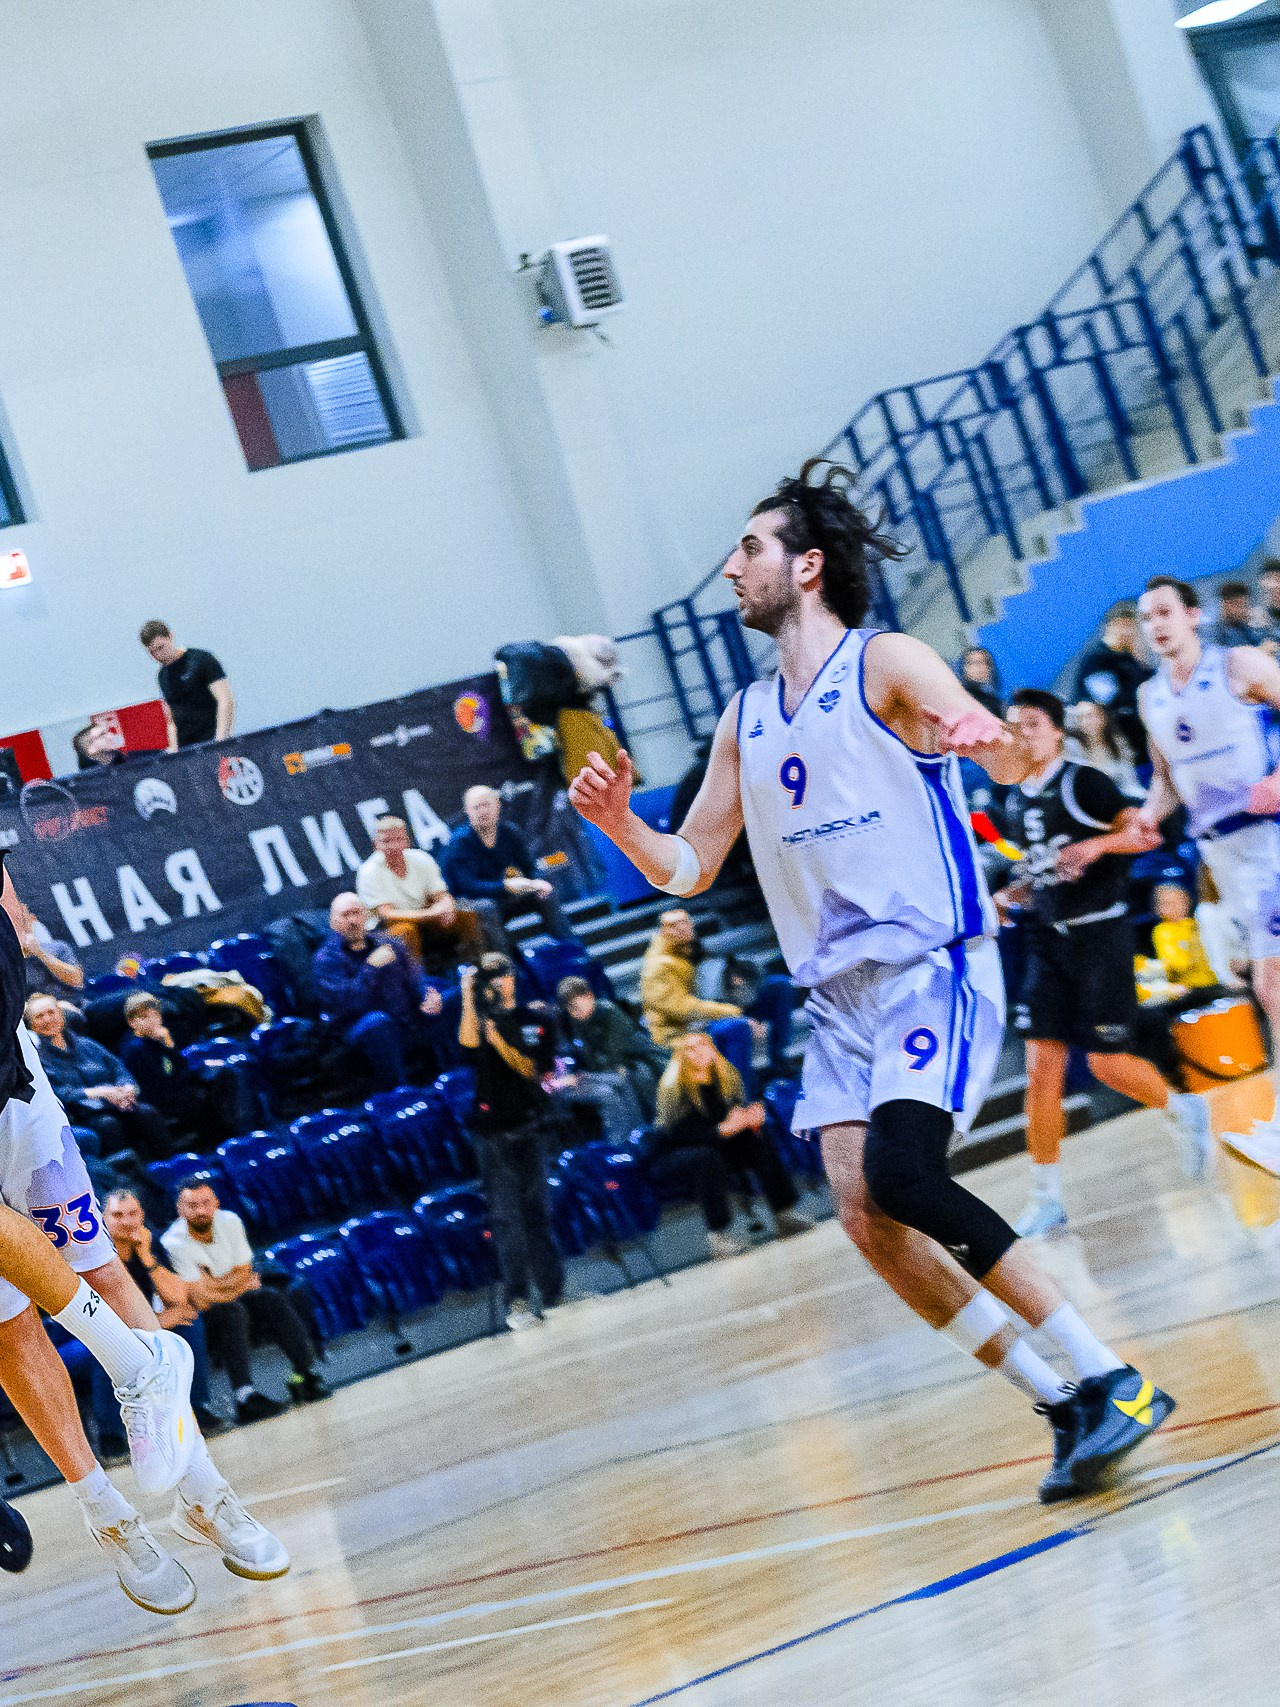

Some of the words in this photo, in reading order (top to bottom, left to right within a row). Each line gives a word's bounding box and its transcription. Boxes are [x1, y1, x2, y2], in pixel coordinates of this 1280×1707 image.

[778, 752, 809, 809] 9
[248, 788, 451, 896] ЛИГА
[900, 1024, 940, 1074] 9
[29, 1190, 100, 1251] 33
